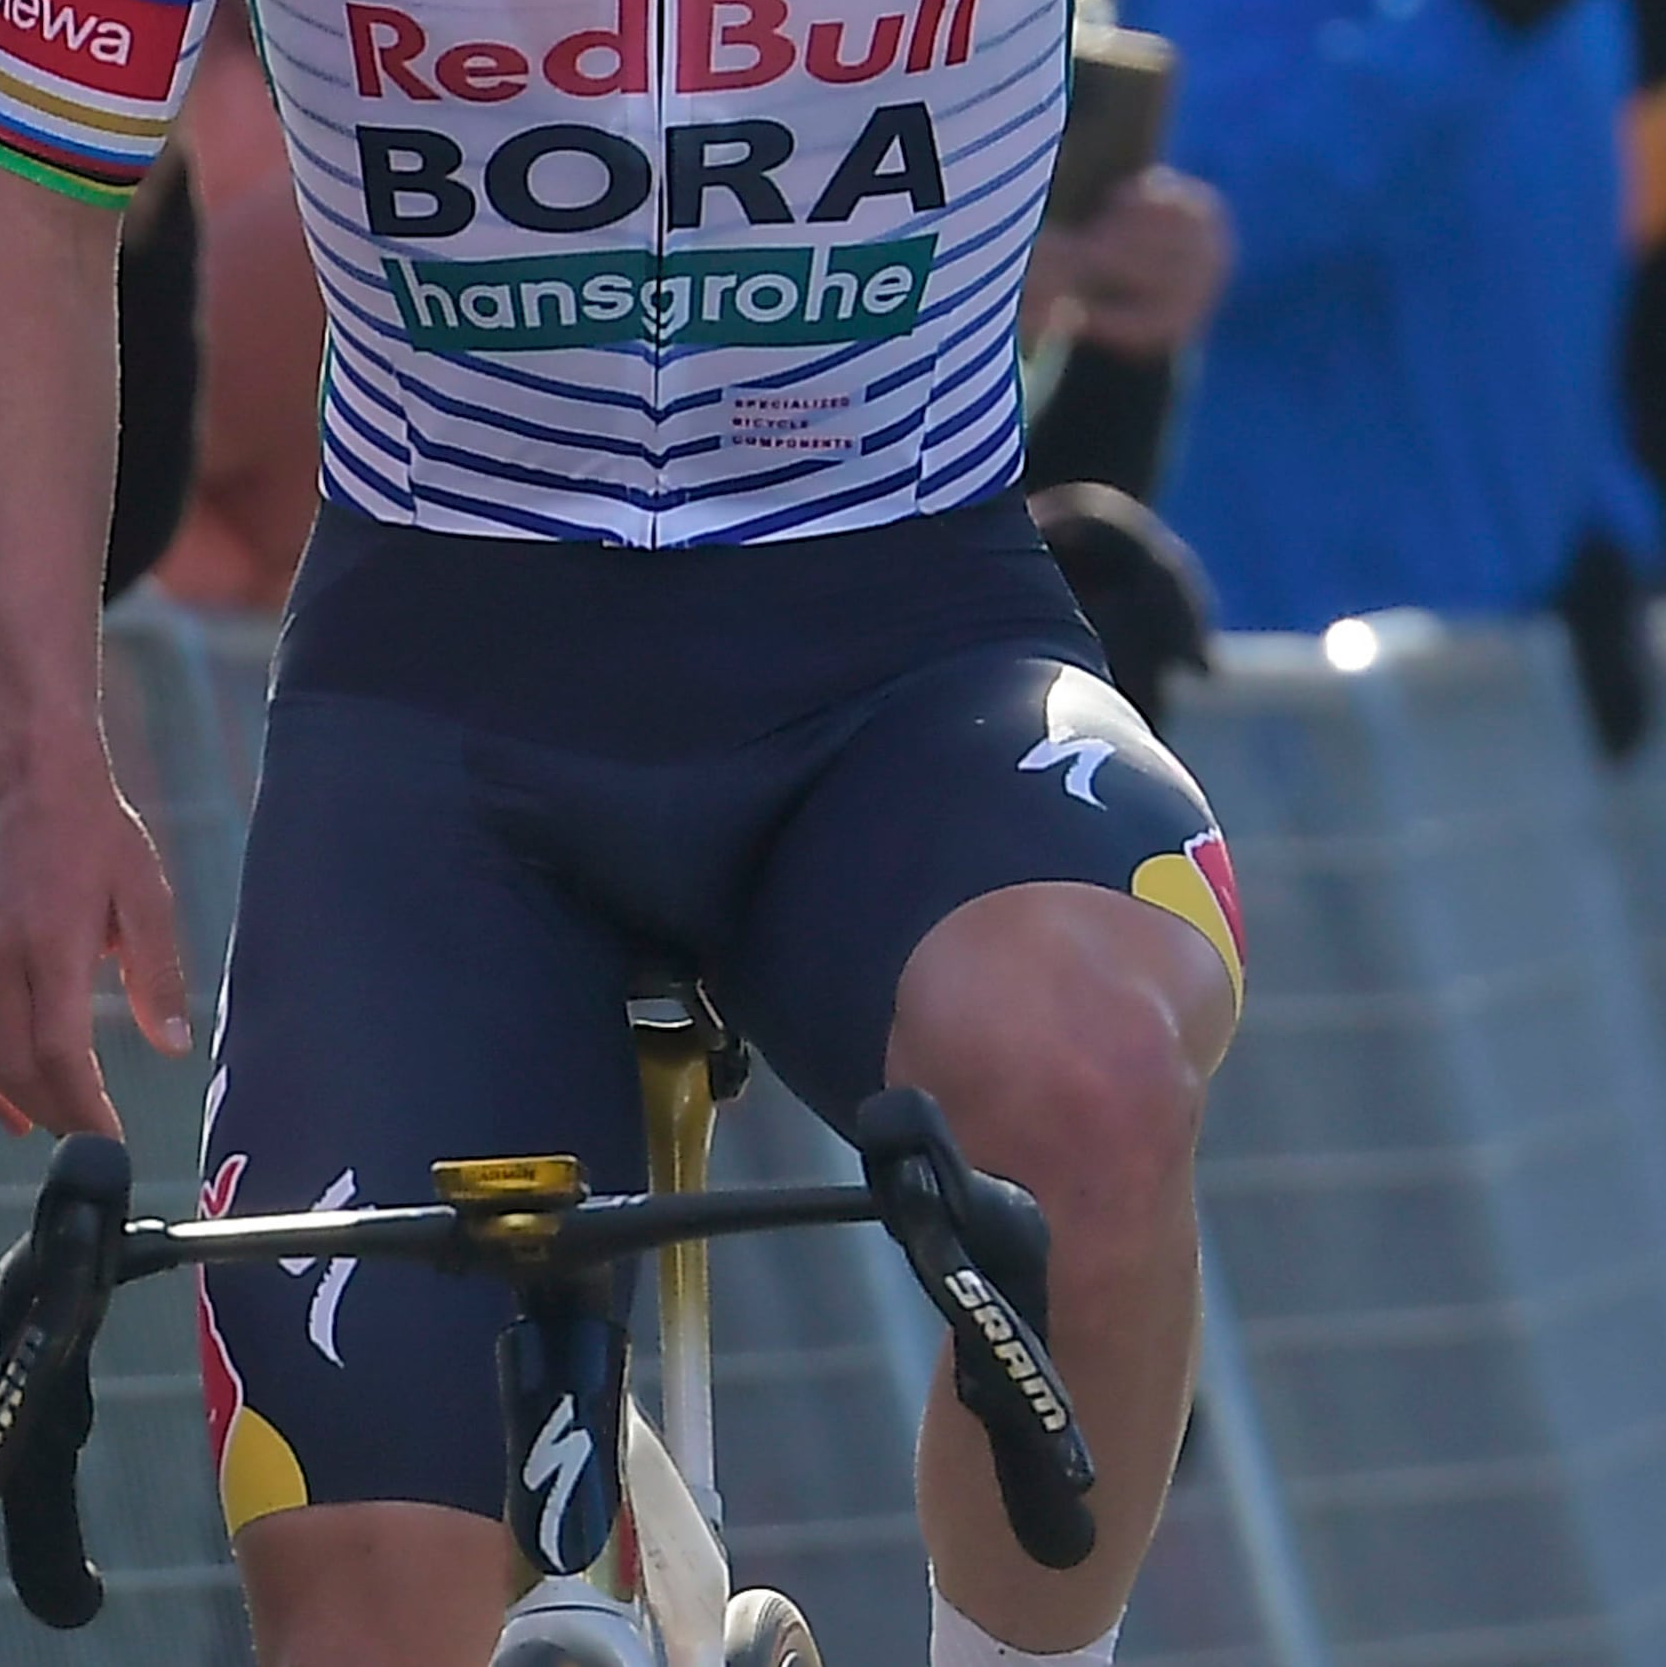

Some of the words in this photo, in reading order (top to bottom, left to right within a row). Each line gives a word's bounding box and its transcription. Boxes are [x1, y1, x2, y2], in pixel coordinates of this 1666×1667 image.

[355, 100, 947, 238] BORA
[400, 245, 915, 337] hansgrohe
[733, 417, 808, 430] BICYCLE
[734, 396, 850, 410] SPECIALIZED
[733, 435, 852, 449] COMPONENTS
[943, 1268, 1069, 1433] SRAM
